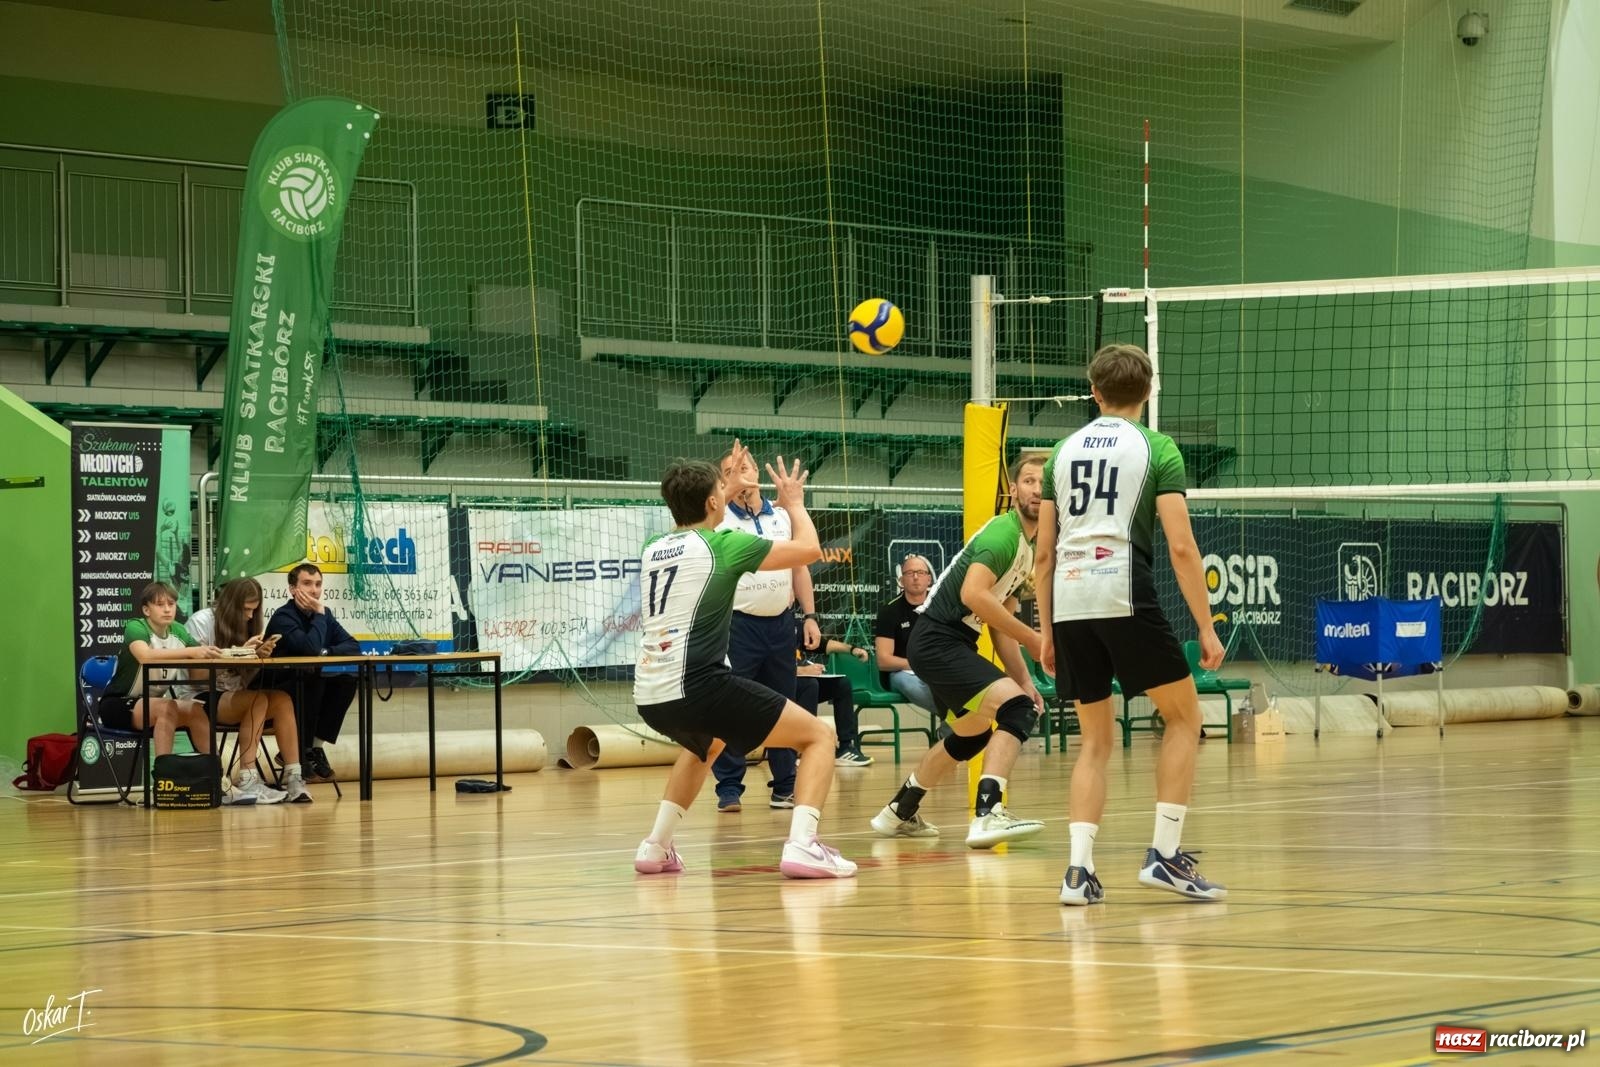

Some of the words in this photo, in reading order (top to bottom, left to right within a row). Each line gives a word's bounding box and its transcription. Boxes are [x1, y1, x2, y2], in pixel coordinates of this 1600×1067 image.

[267, 156, 293, 185] KLUB
[294, 152, 335, 205] SIATKARSKI
[270, 207, 326, 236] RACIBÓRZ
[240, 253, 276, 419] SIATKARSKI
[264, 309, 296, 453] RACIBÓRZ
[79, 433, 137, 455] Szukamy
[1083, 437, 1118, 448] RZYTKI
[80, 453, 134, 473] MŁODYCH
[230, 434, 253, 502] KLUB
[81, 475, 149, 487] TALENTÓW
[1069, 459, 1119, 517] 54
[86, 493, 117, 502] SIATKÓWKA
[117, 493, 147, 502] CHŁOPCÓW
[94, 511, 127, 520] MŁODZICY
[128, 511, 140, 520] U15
[95, 532, 119, 541] KADECI
[119, 532, 131, 540] U17
[478, 541, 542, 554] RADIO
[95, 552, 127, 561] JUNIORZY
[128, 552, 140, 560] U19
[81, 571, 122, 580] MINISIATKÓWKA
[123, 571, 153, 580] CHŁOPCÓW
[1202, 554, 1281, 606] OSiR
[96, 588, 119, 597] SINGLE
[120, 588, 132, 596] U10
[270, 588, 289, 600] 414
[323, 588, 340, 600] 502
[403, 588, 420, 601] 363
[423, 588, 439, 600] 647
[649, 565, 679, 617] 17
[813, 584, 845, 593] JLEPSZYM
[97, 602, 122, 612] DWÓJKI
[122, 603, 133, 612] U11
[350, 610, 367, 619] von
[427, 608, 433, 619] 2
[1232, 608, 1281, 625] RACIBÓRZ
[97, 617, 120, 628] TRÓJKI
[120, 619, 129, 628] U1
[1324, 623, 1370, 638] molten
[114, 741, 138, 749] Racibó
[157, 780, 174, 791] 3D
